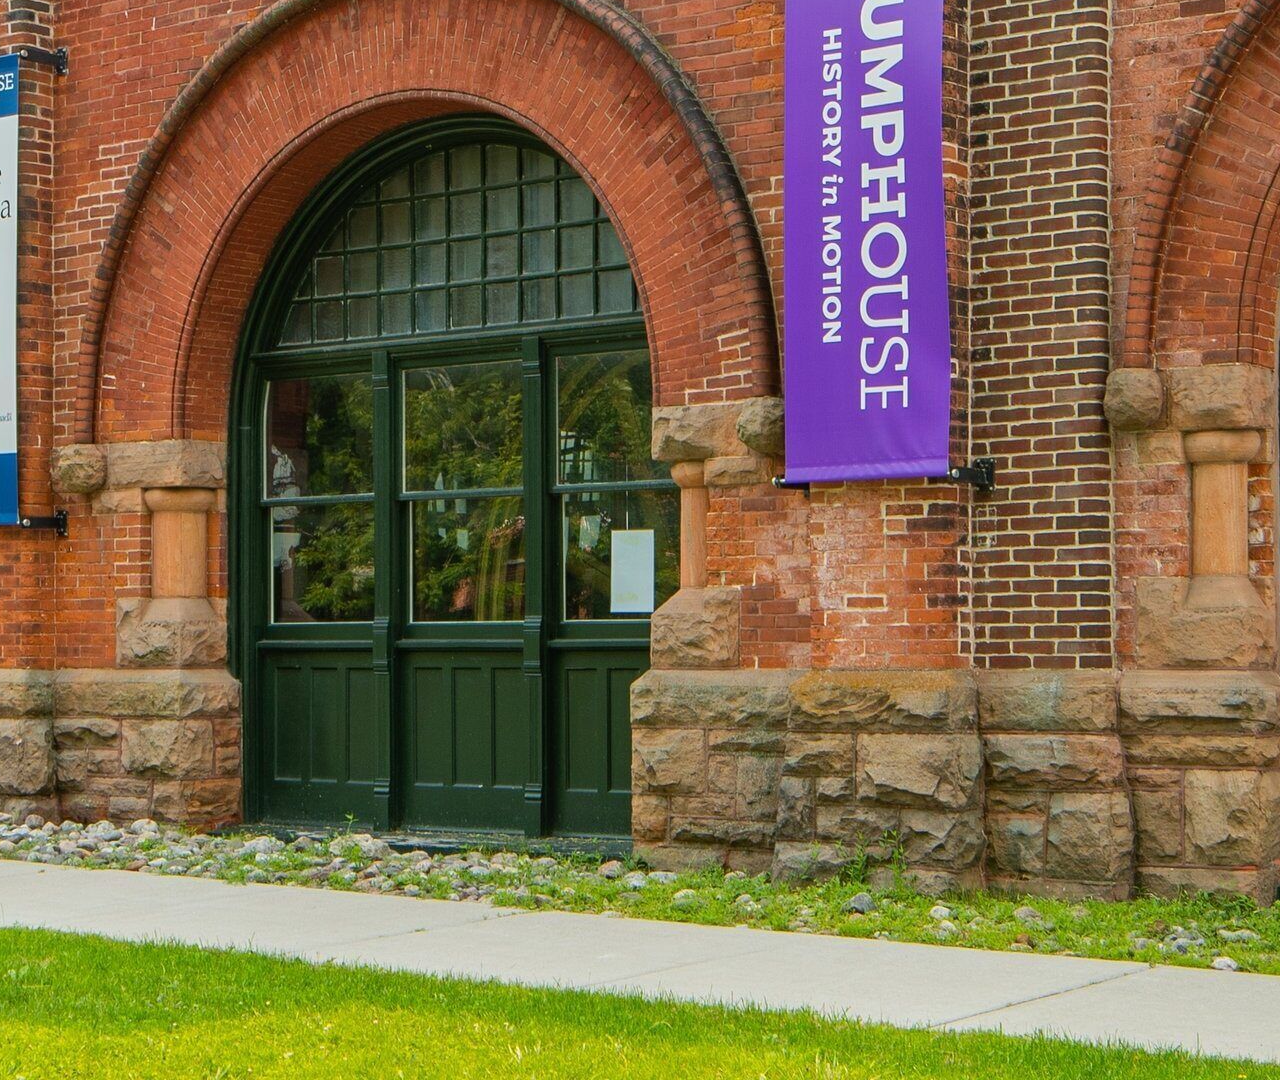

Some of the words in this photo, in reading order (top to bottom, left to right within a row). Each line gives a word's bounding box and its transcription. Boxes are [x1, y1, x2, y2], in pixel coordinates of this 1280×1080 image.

[822, 28, 843, 167] HISTORY
[822, 174, 844, 207] in
[822, 215, 842, 343] MOTION
